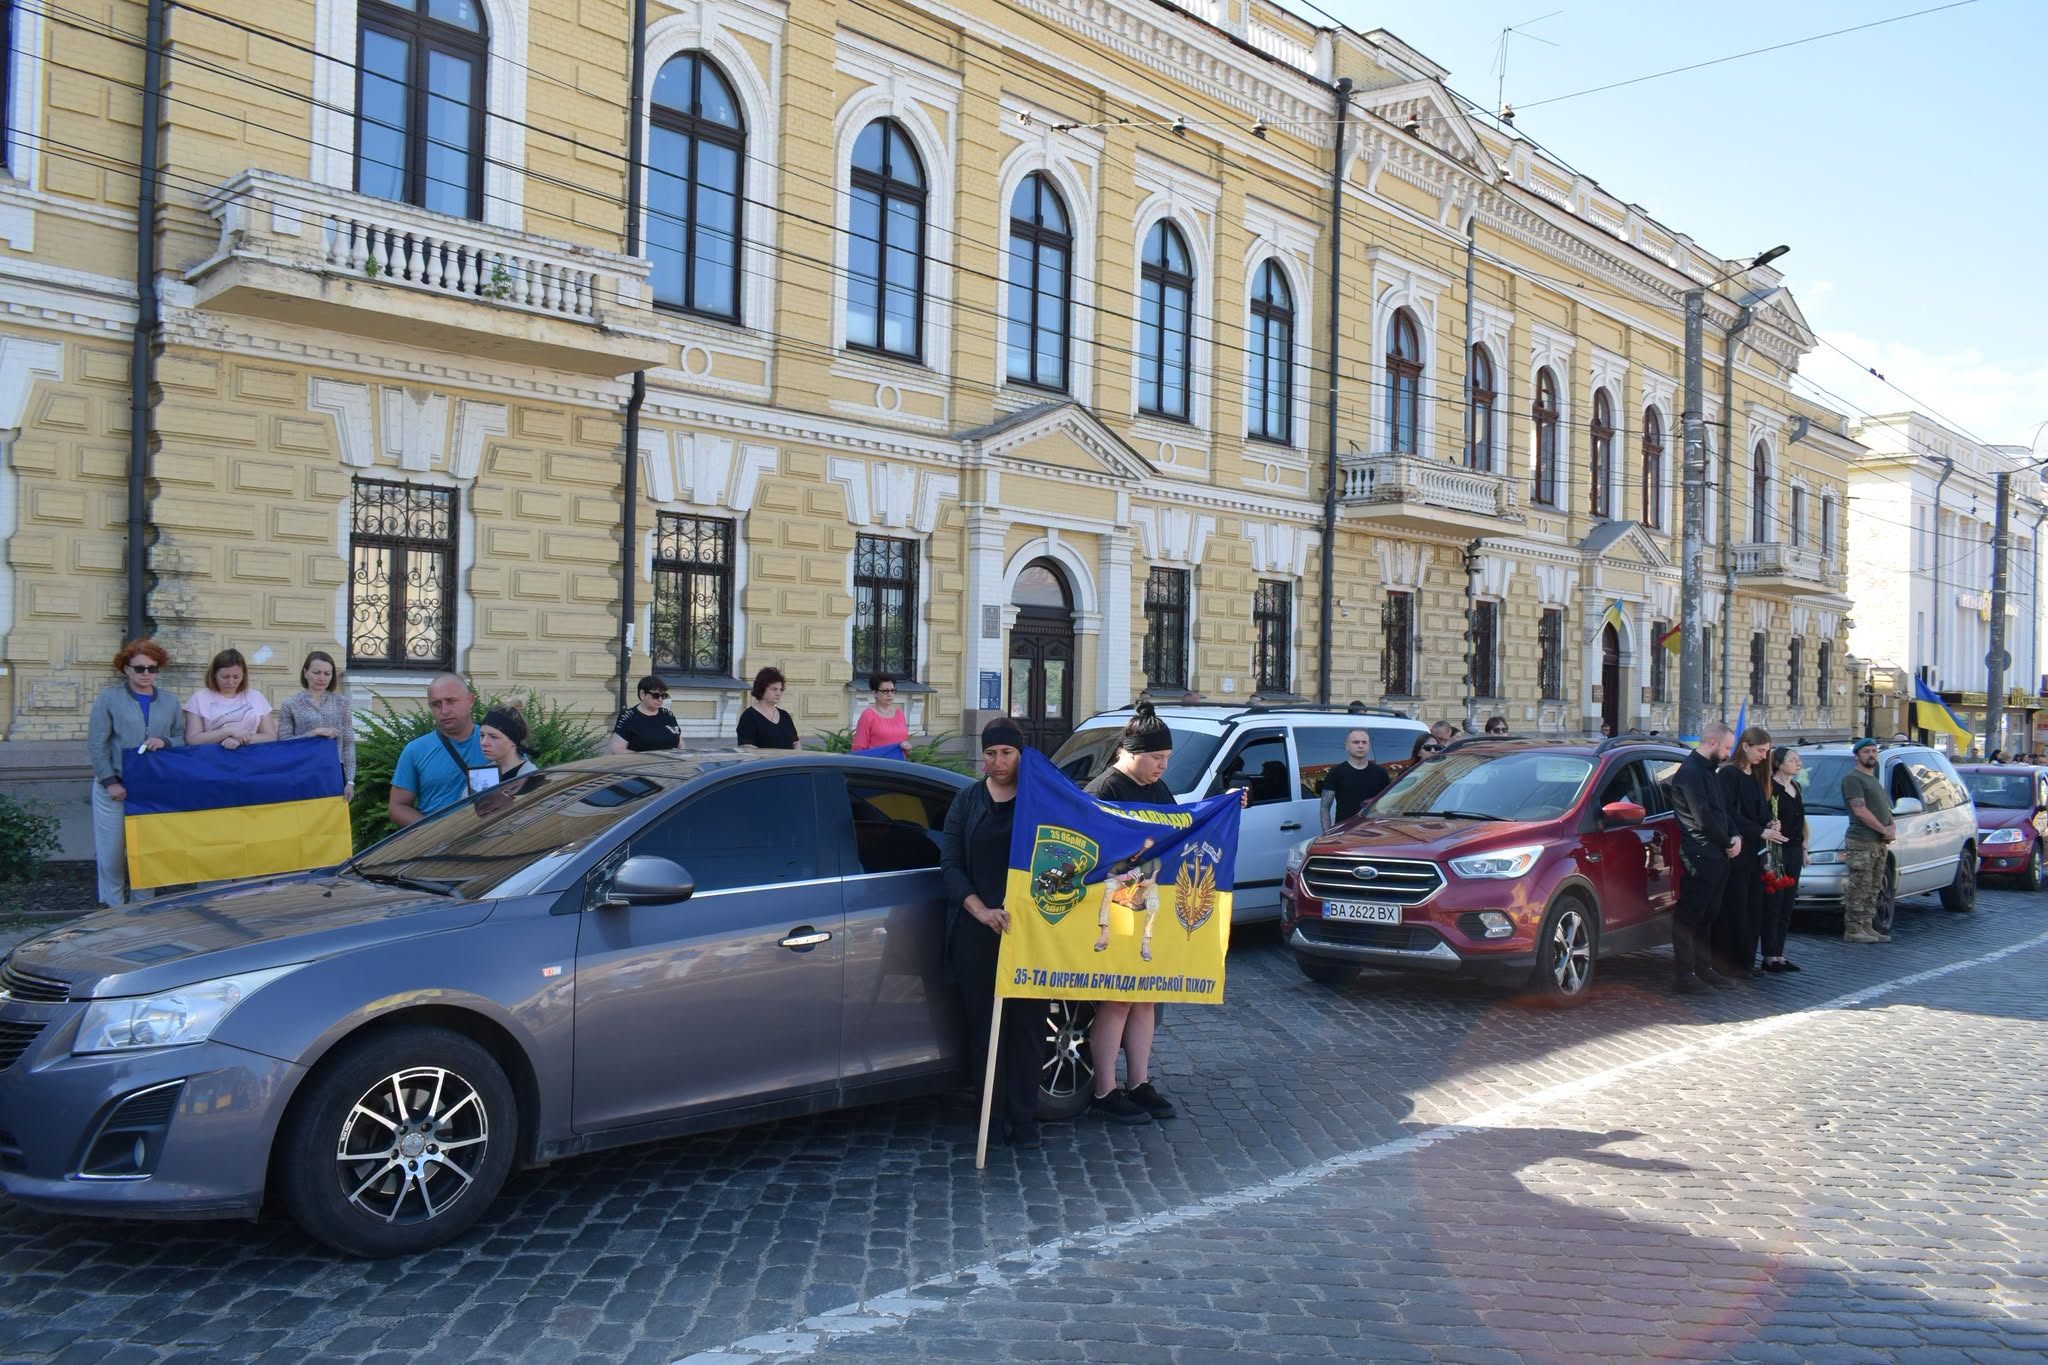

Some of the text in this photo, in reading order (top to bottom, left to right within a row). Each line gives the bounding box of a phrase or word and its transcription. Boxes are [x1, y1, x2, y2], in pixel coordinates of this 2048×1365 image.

[1050, 829, 1061, 840] 35
[1330, 903, 1395, 920] BA 2622 BX
[1014, 968, 1047, 986] 35-ТА
[1049, 971, 1089, 989] ОКРЕМА
[1090, 973, 1136, 992] БРИГАДА
